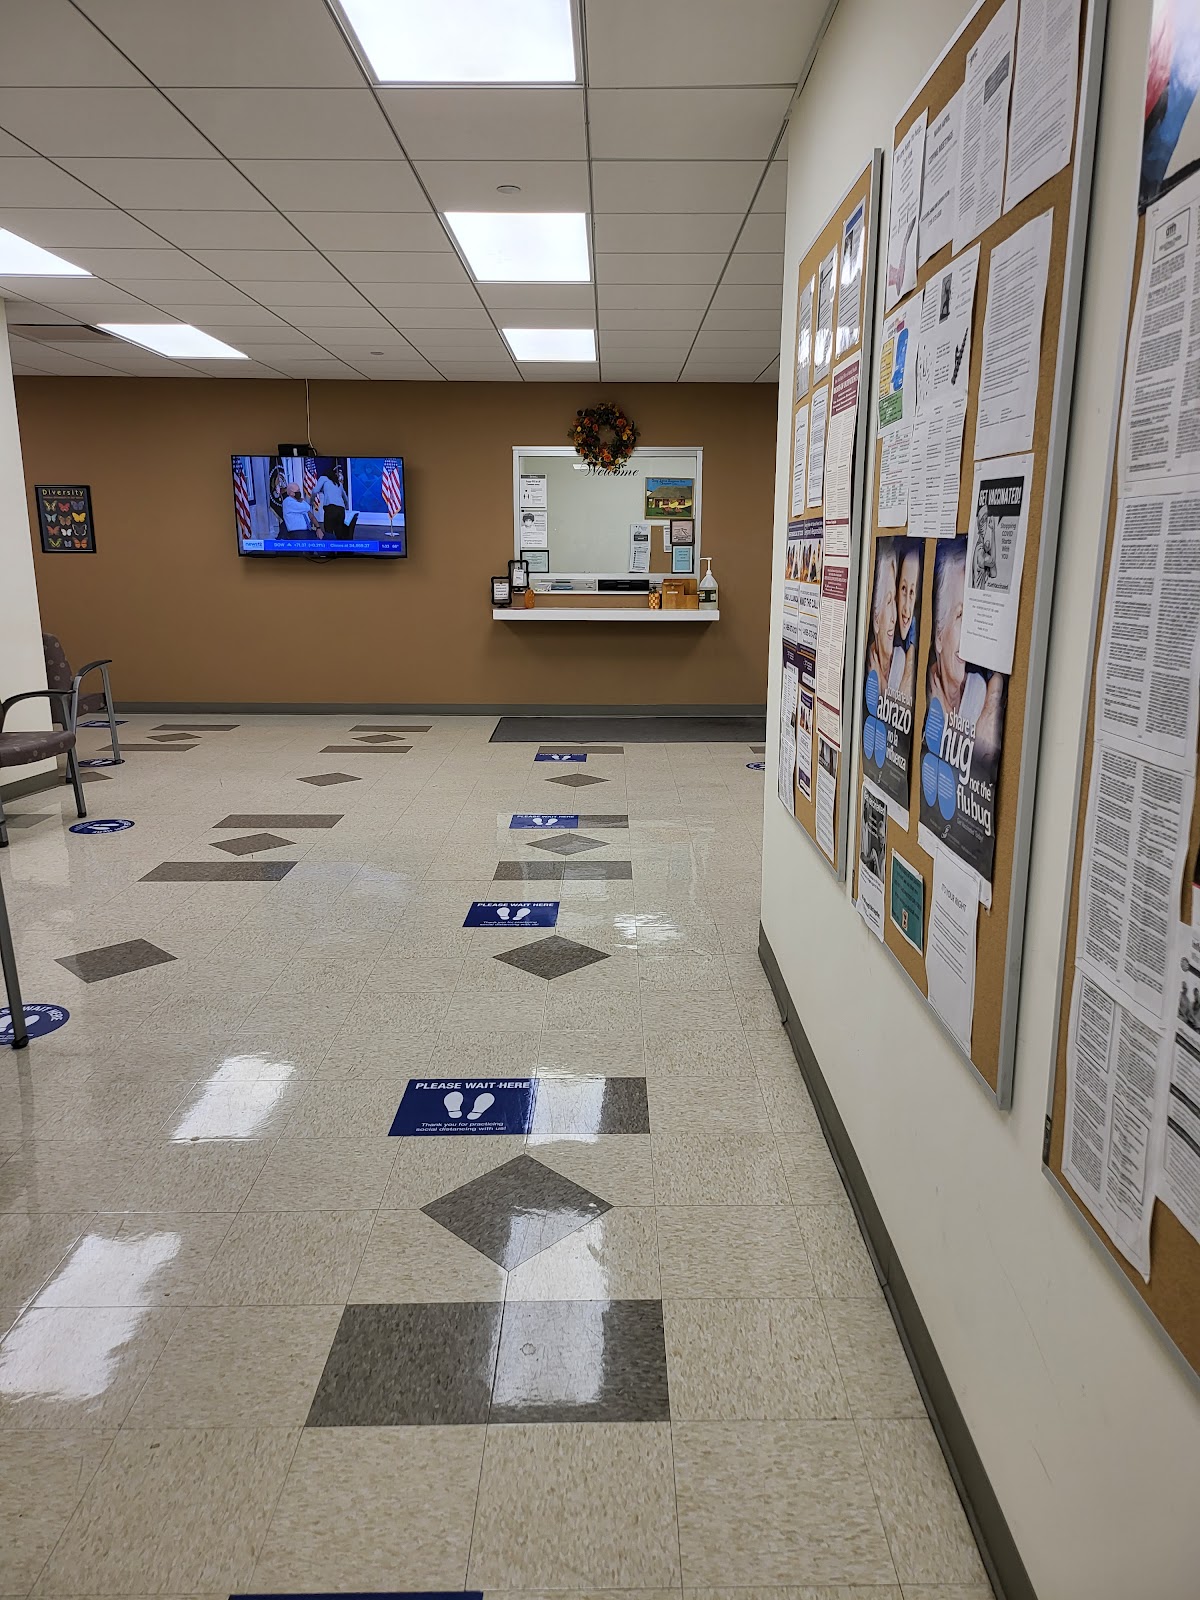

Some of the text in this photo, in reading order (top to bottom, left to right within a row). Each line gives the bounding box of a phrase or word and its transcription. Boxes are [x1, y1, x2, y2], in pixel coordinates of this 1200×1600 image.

[580, 462, 639, 477] Welcome
[42, 489, 84, 497] Diversity
[988, 486, 1022, 505] VACCINATED!
[877, 689, 912, 735] abrazo
[949, 707, 970, 735] share
[970, 722, 976, 739] a
[940, 712, 975, 785] hug
[969, 777, 980, 795] not
[980, 780, 992, 801] the
[957, 783, 991, 836] flu bug
[415, 1082, 462, 1090] PLEASE
[497, 1081, 530, 1089] HERE
